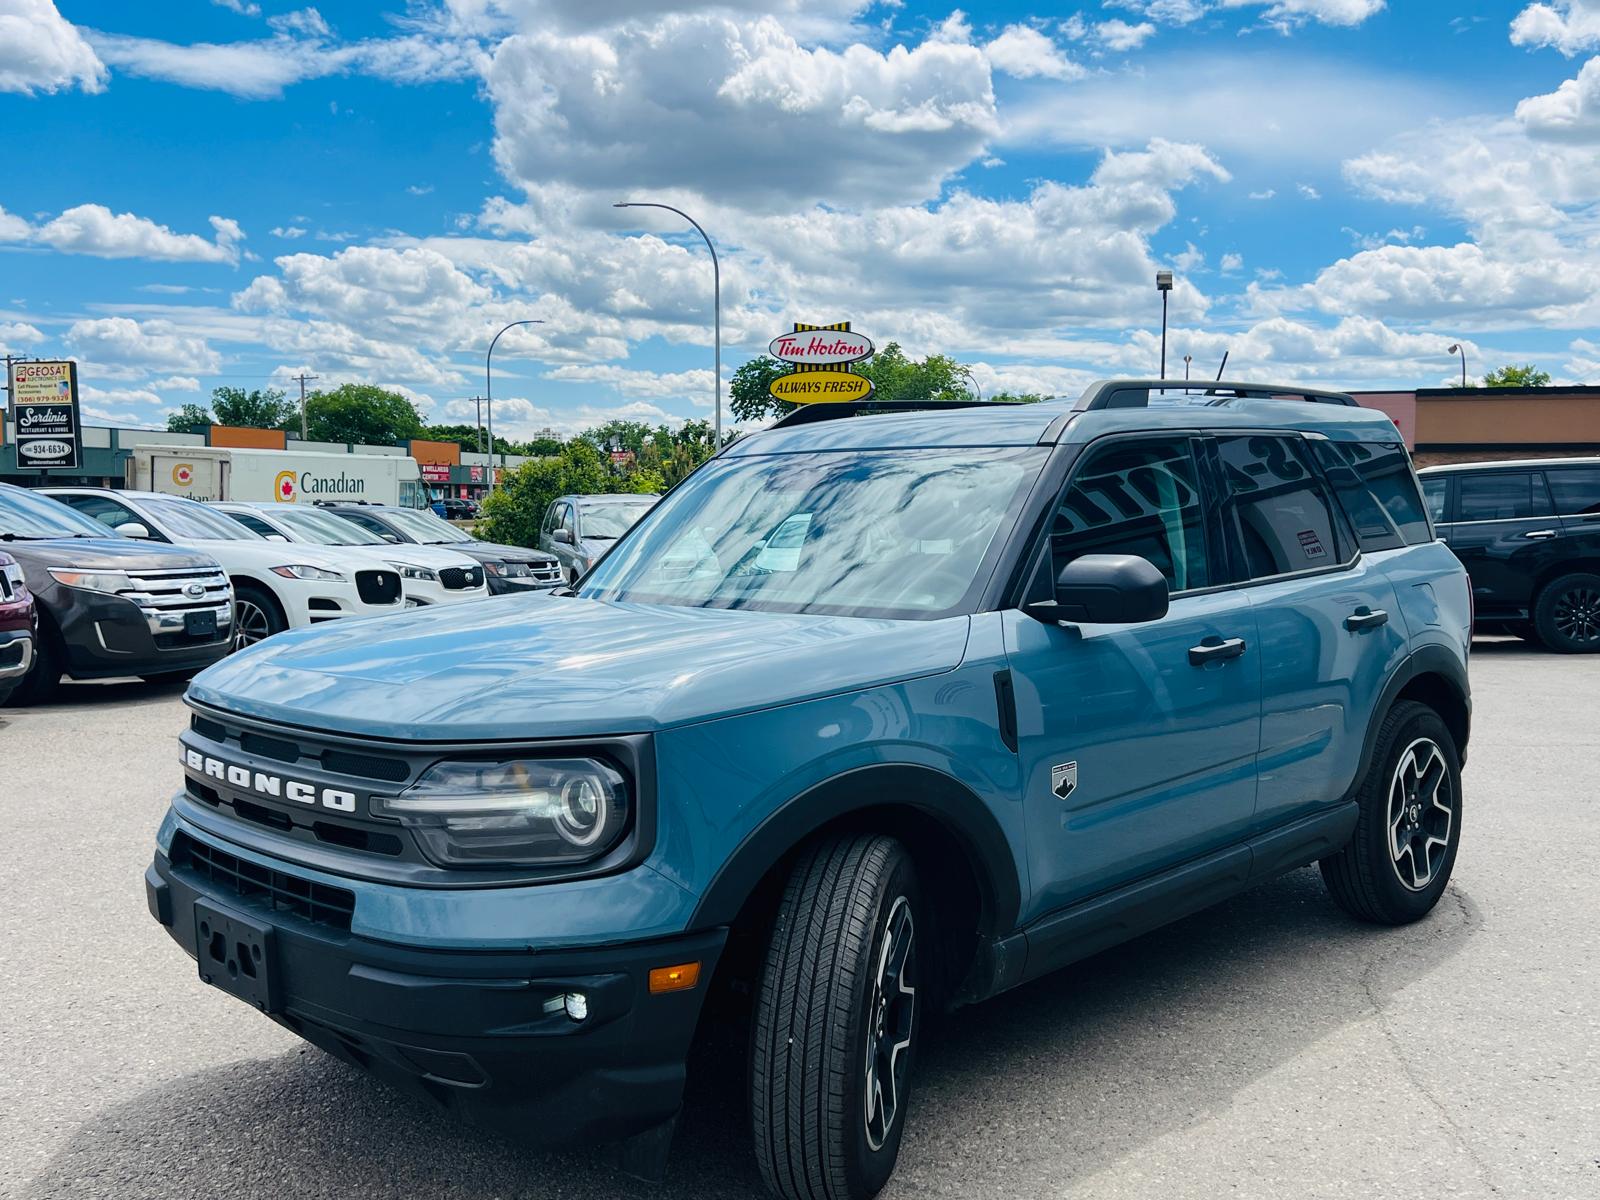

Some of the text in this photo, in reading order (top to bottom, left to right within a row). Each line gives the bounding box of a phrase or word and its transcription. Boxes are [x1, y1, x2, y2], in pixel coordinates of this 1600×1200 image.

[778, 337, 864, 356] Tim Hortons
[27, 366, 66, 376] GEOSAT
[775, 381, 864, 394] ALWAYS FRESH
[20, 407, 69, 427] Sardinia
[33, 444, 65, 454] 934-6634
[300, 471, 365, 494] Canadian
[187, 749, 356, 813] BRONCO
